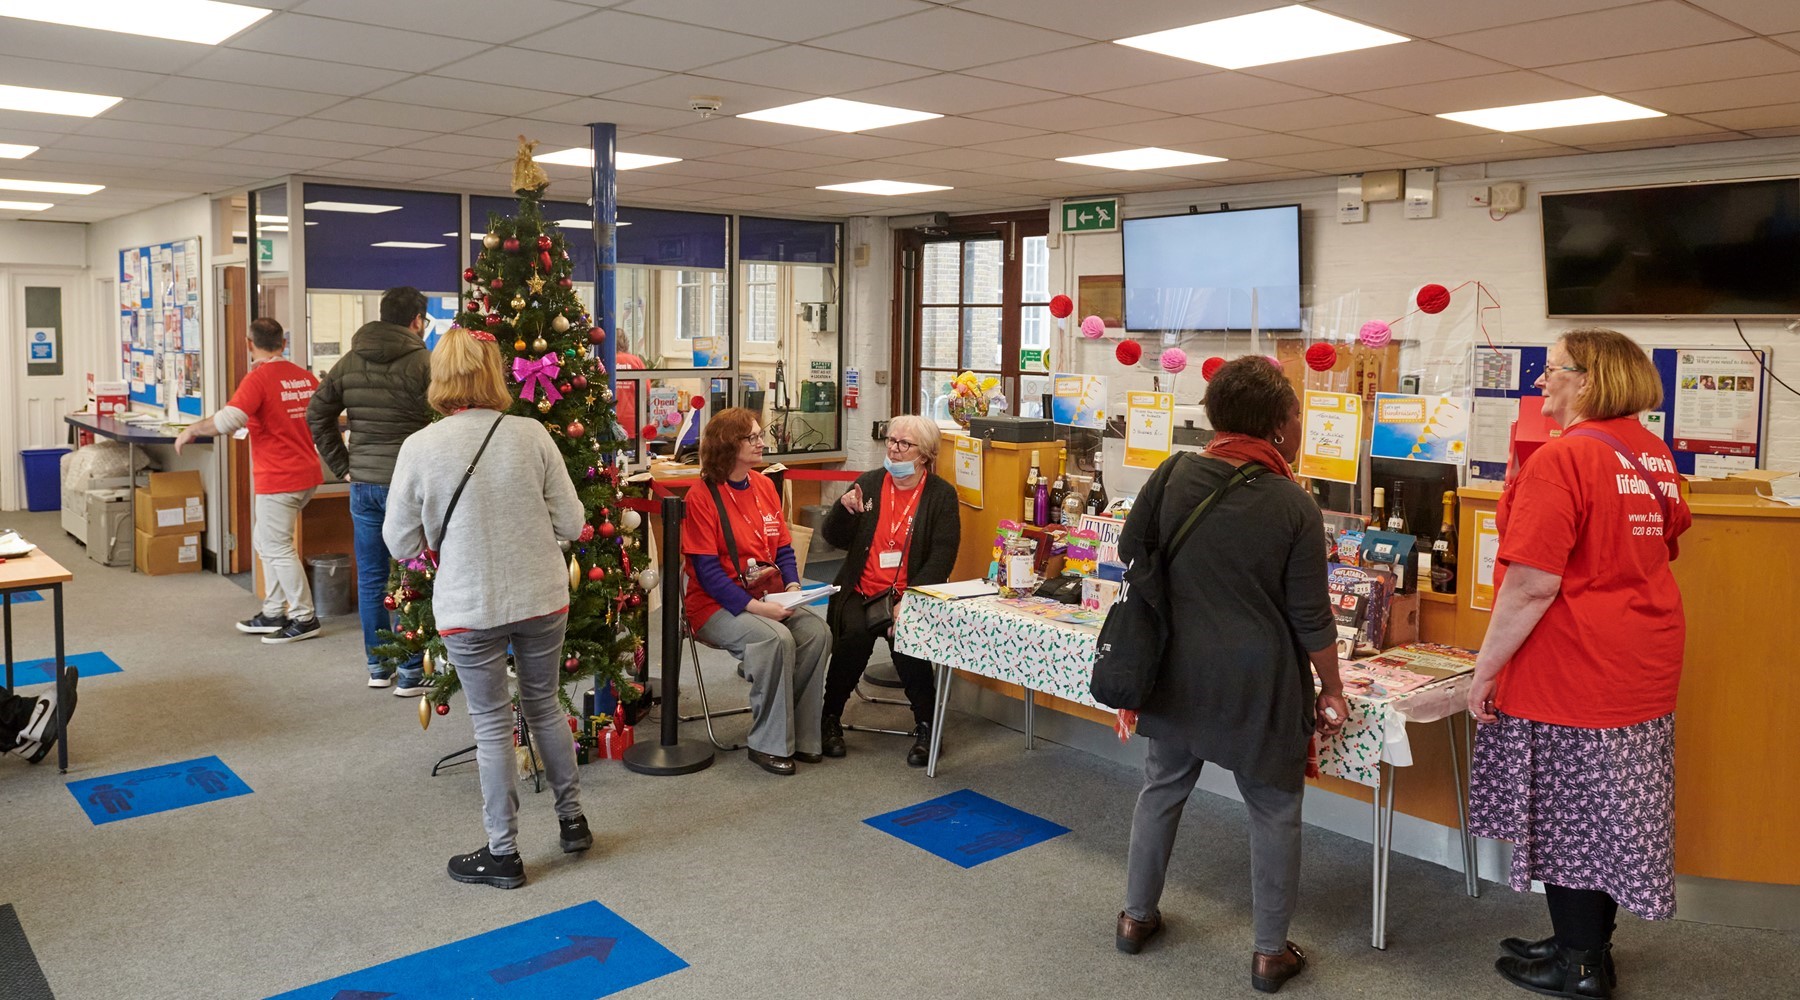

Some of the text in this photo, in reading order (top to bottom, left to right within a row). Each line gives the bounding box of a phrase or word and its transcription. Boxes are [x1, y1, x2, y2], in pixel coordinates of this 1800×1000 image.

[1367, 382, 1376, 400] Rm
[653, 398, 674, 408] Open
[653, 408, 667, 416] day
[1632, 526, 1644, 536] 020
